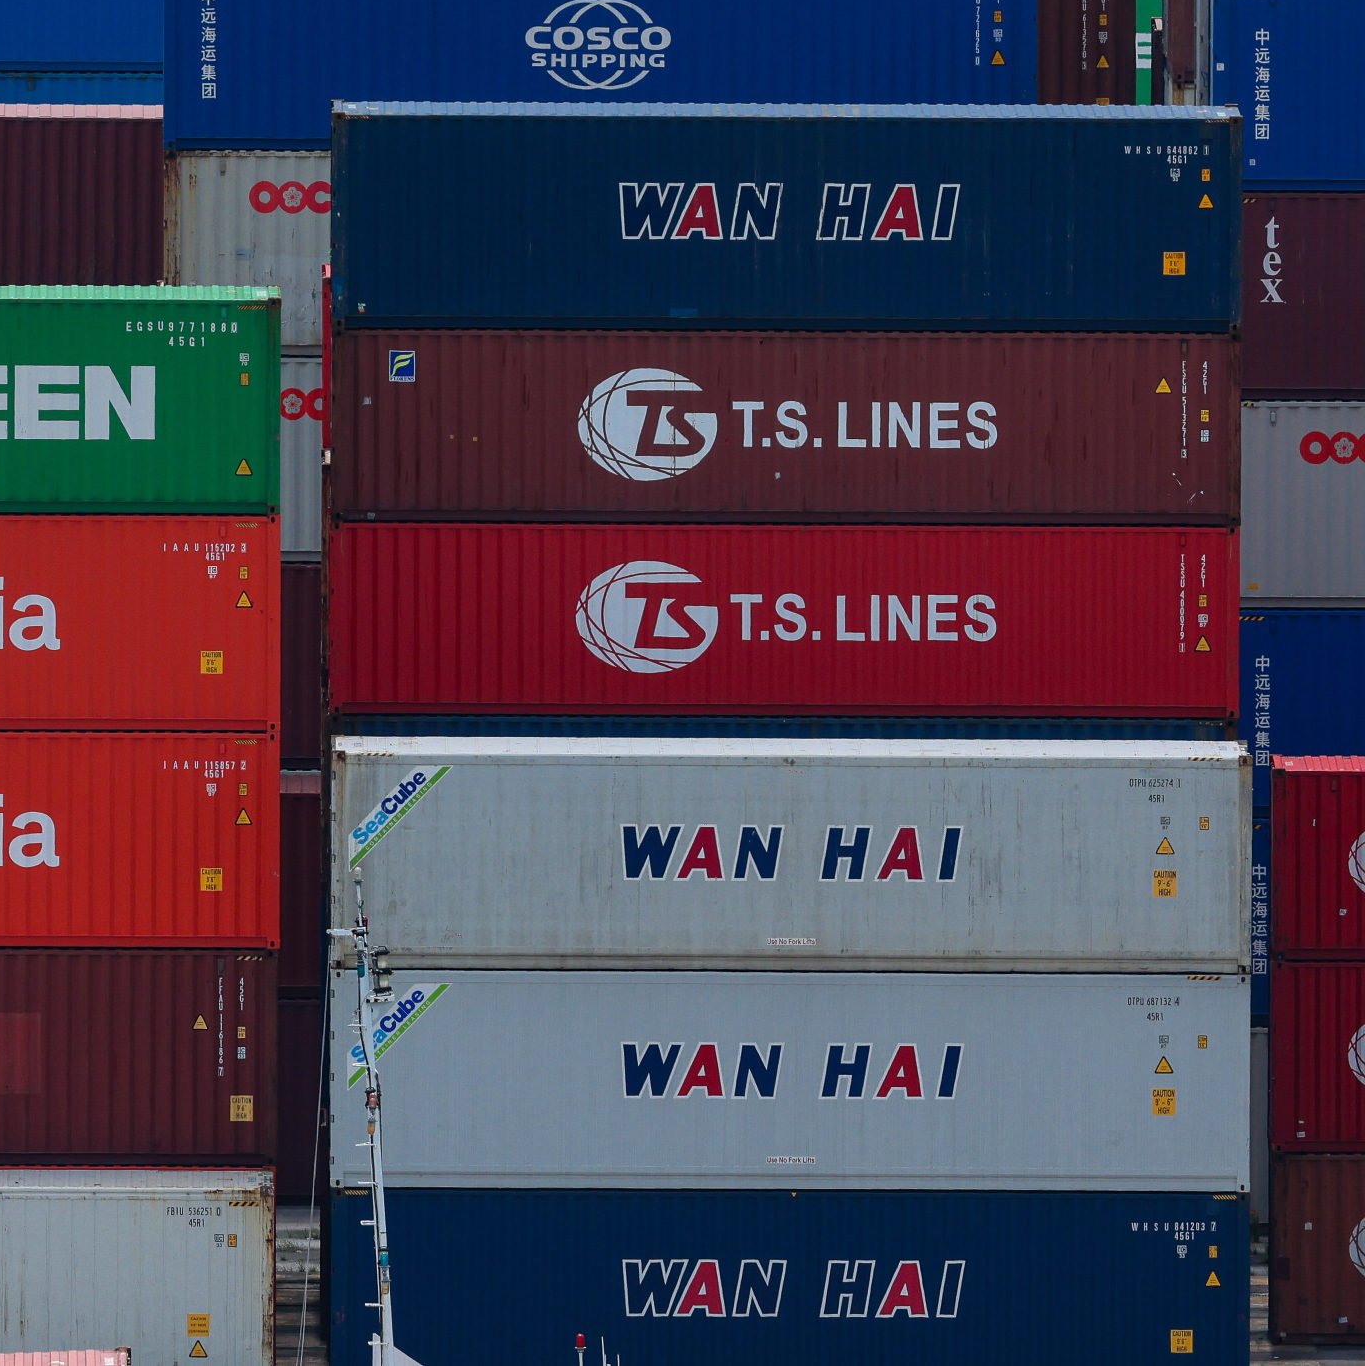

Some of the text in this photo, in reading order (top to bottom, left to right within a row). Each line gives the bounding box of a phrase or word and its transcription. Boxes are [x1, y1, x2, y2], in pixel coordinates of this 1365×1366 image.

[525, 25, 672, 51] COSCO
[531, 52, 666, 70] SHIPPING
[1254, 28, 1271, 141] 中远海运集团
[1166, 145, 1199, 156] 644862
[1166, 155, 1188, 165] 45G1
[619, 182, 961, 241] WAN HAI
[1260, 215, 1286, 304] tex
[125, 321, 239, 334] EGSU9771880
[168, 336, 206, 347] 45G1
[1201, 360, 1209, 395] 42G1
[732, 400, 998, 449] T.S. LINES
[204, 543, 237, 554] 115202
[205, 552, 226, 562] 45G1
[730, 593, 997, 642] T.S. LINES
[201, 651, 223, 659] CAUTION
[1254, 654, 1271, 766] 中远海运集团
[204, 760, 237, 770] 115857
[204, 769, 226, 779] 45G1
[1147, 778, 1174, 789] 625274
[1148, 794, 1166, 804] 45R1
[352, 770, 428, 846] SeaCube
[621, 823, 964, 883] WAN HAI
[1153, 870, 1177, 879] CAUTION
[1158, 888, 1172, 897] HIGH
[1251, 863, 1268, 976] 中远海运集团
[779, 937, 787, 945] No
[1127, 997, 1172, 1007] OTPU 687132
[1146, 1012, 1165, 1022] 45R1
[621, 1041, 965, 1100] WAN HAI
[1152, 1089, 1176, 1098] CAUTION
[231, 1097, 253, 1105] CAUTION
[1157, 1107, 1171, 1116] HIGH
[779, 1156, 787, 1164] No
[789, 1156, 801, 1164] Fork
[166, 1206, 213, 1217] FBIU 536251
[188, 1218, 206, 1228] 45R1
[1131, 1221, 1206, 1232] WHSU 841203
[1173, 1231, 1195, 1241] 45G1
[622, 1258, 966, 1319] WAN HAI
